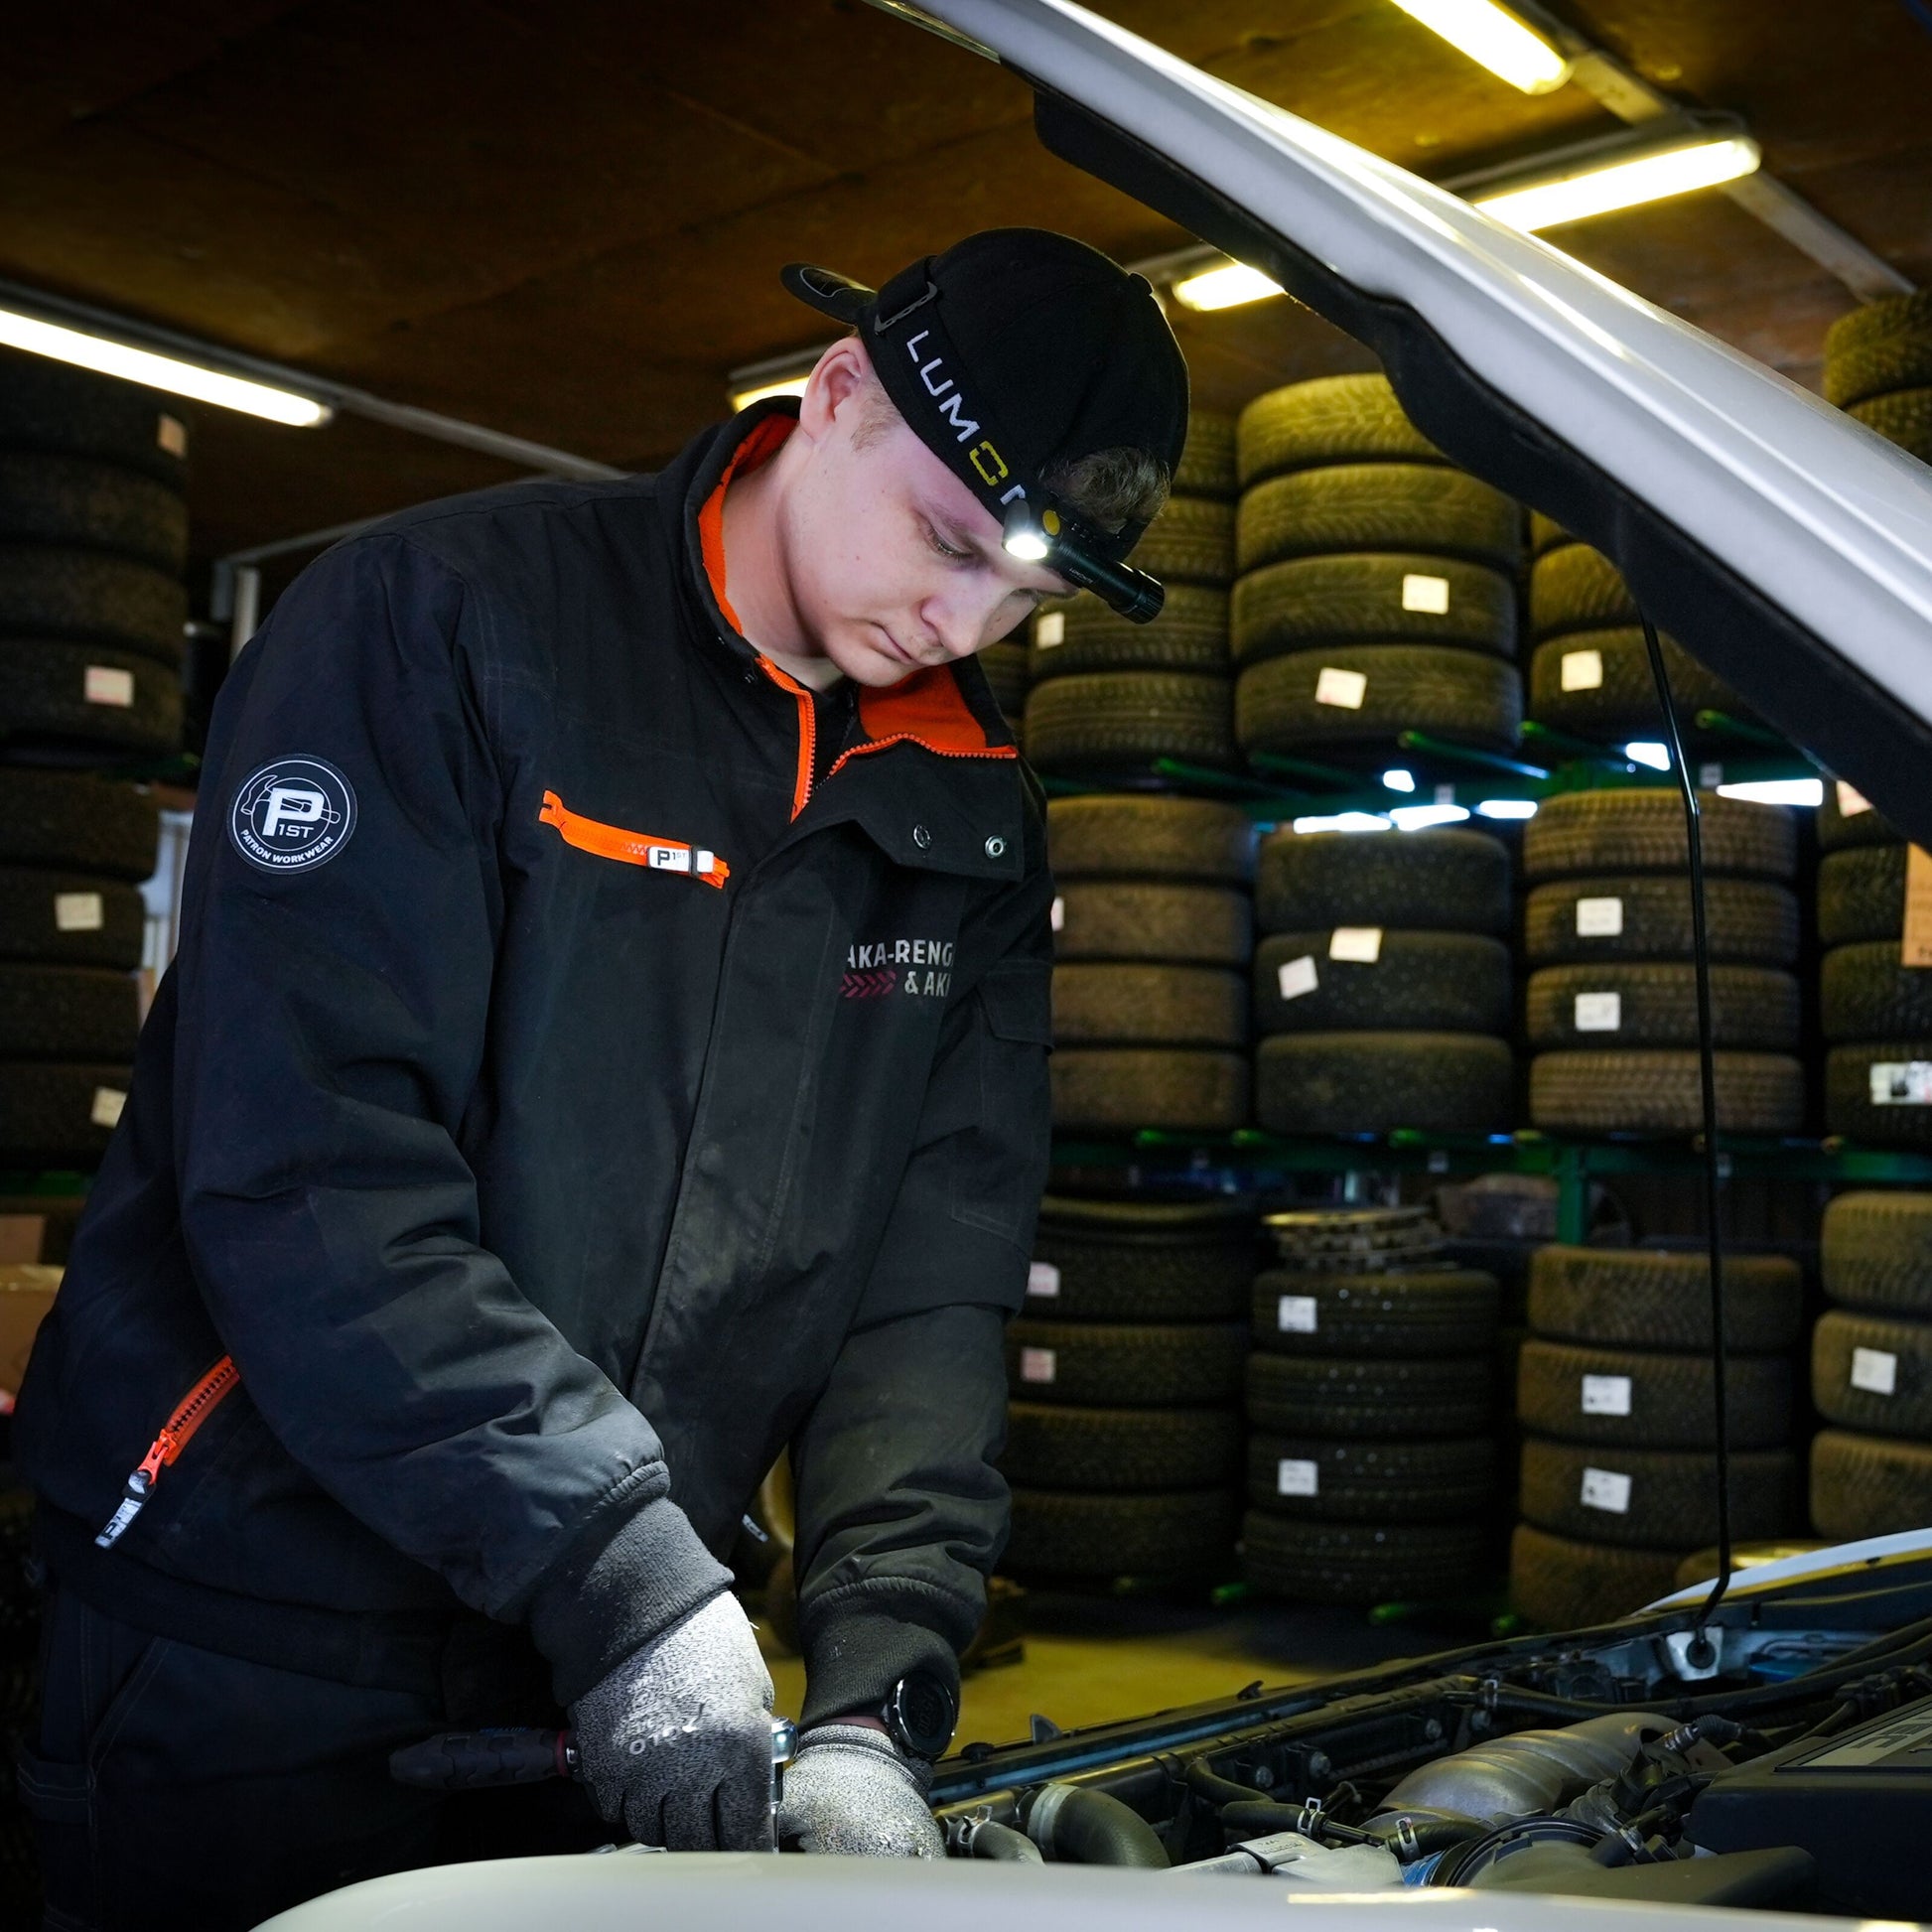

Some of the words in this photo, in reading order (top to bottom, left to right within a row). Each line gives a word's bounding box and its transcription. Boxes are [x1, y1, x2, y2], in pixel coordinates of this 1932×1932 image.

[262, 787, 325, 836] P
[279, 824, 314, 838] 1ST
[240, 829, 272, 860] PATRON
[272, 836, 334, 864] WORKWEAR
[904, 970, 919, 995] &
